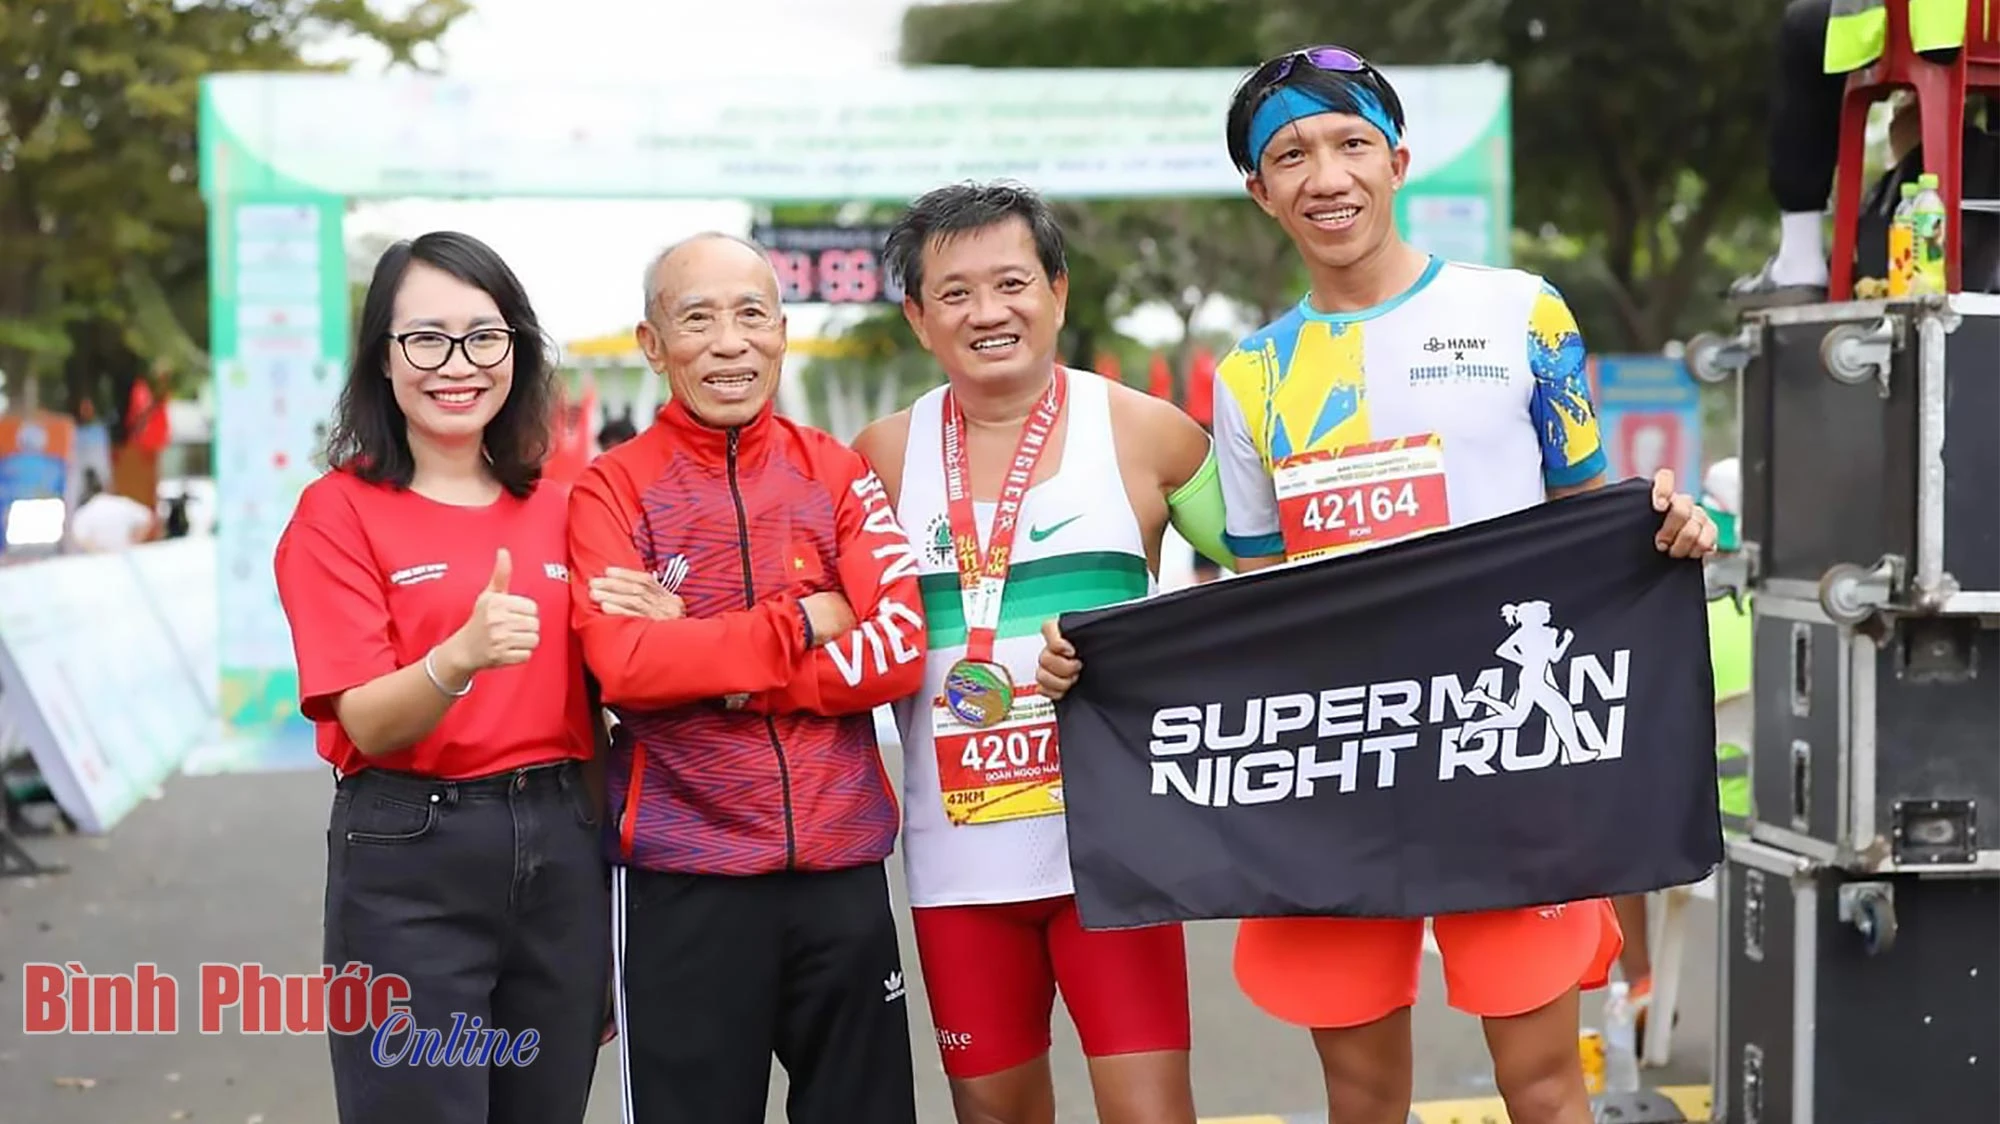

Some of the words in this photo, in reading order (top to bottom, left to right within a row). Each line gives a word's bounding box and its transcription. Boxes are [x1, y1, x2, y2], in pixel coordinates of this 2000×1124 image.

[1447, 338, 1487, 350] HAMY
[1000, 410, 1056, 518] FINISHER
[1302, 481, 1420, 532] 42164
[1148, 648, 1631, 757] SUPERMN
[961, 728, 1060, 771] 4207
[1150, 731, 1418, 808] NIGHT
[1437, 704, 1626, 781] RUN
[947, 790, 985, 805] 42KM
